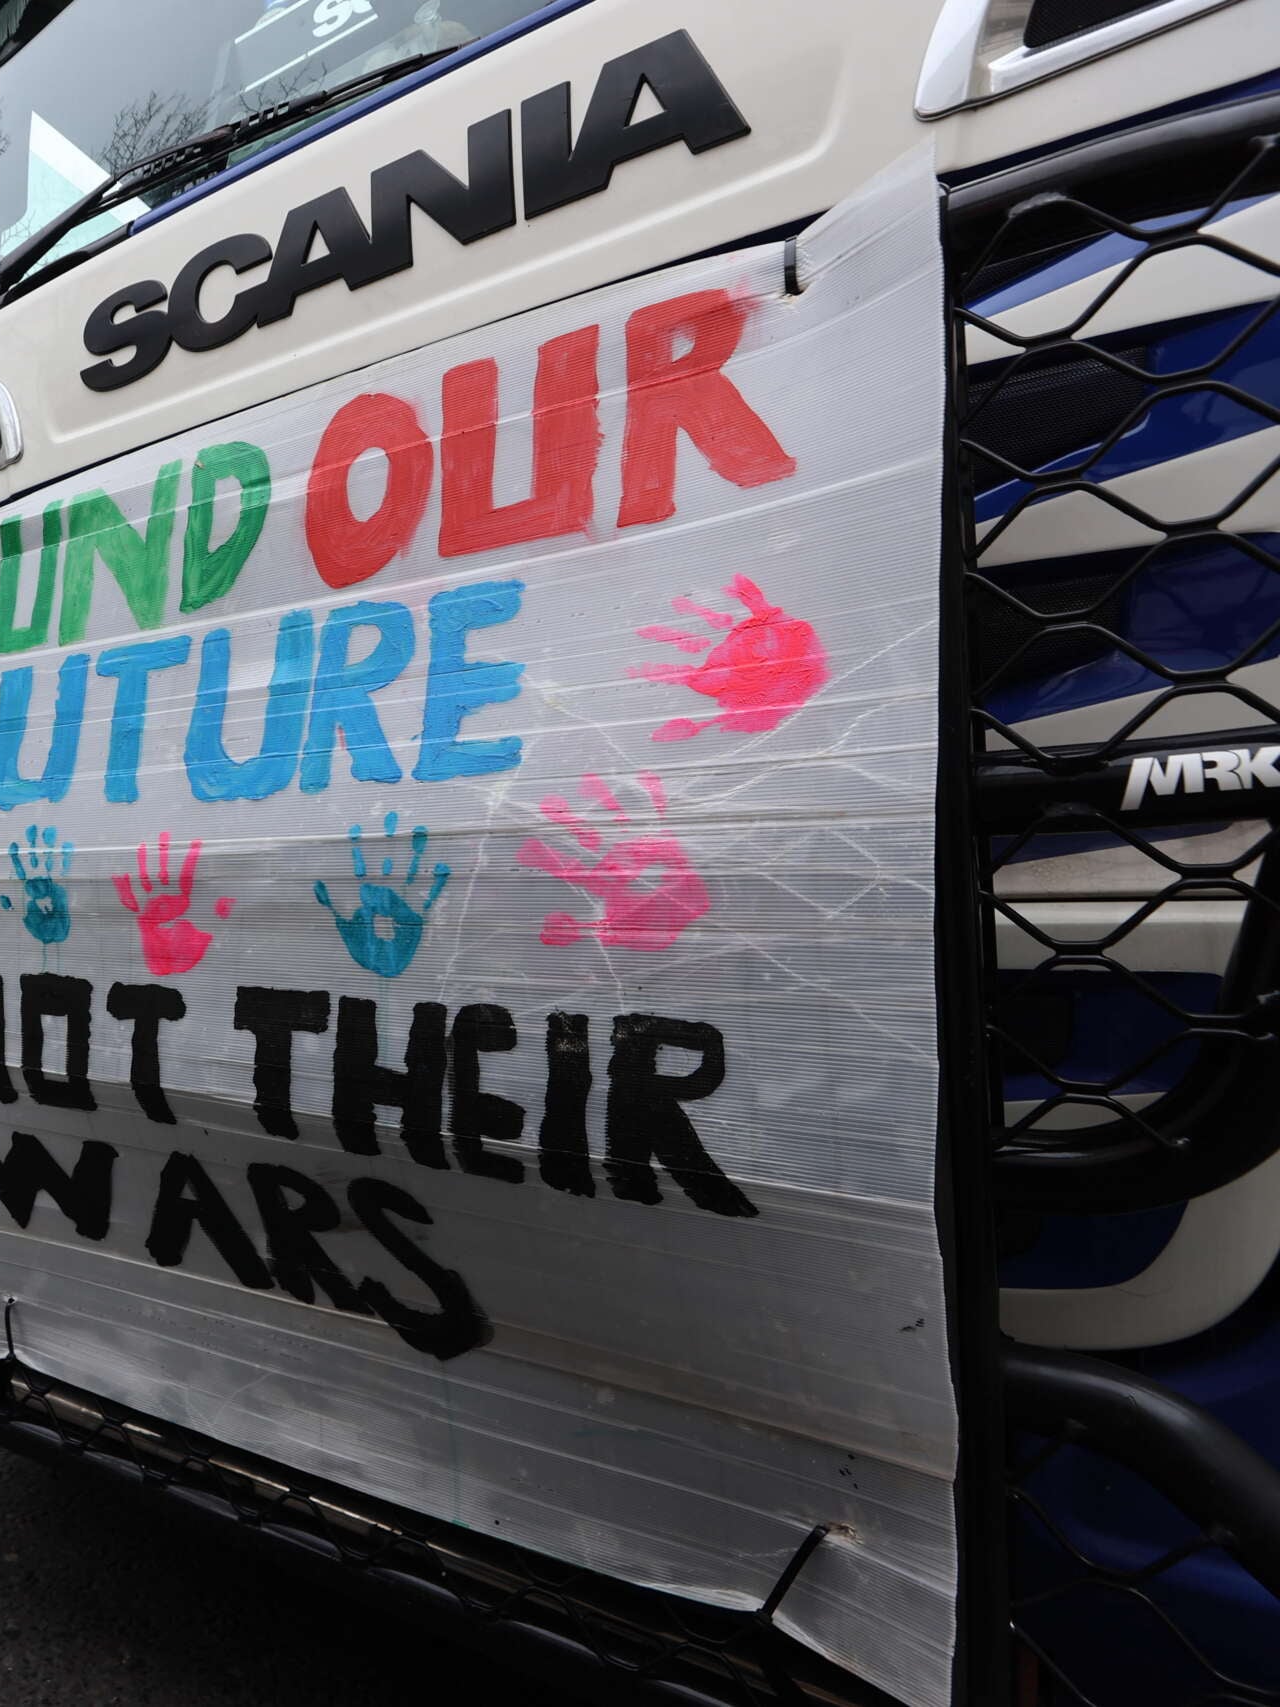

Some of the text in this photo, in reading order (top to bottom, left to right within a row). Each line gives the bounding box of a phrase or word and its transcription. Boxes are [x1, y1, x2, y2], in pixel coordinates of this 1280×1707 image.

[80, 28, 751, 392] SCANIA
[305, 288, 797, 589] OUR
[233, 984, 760, 1218] THEIR
